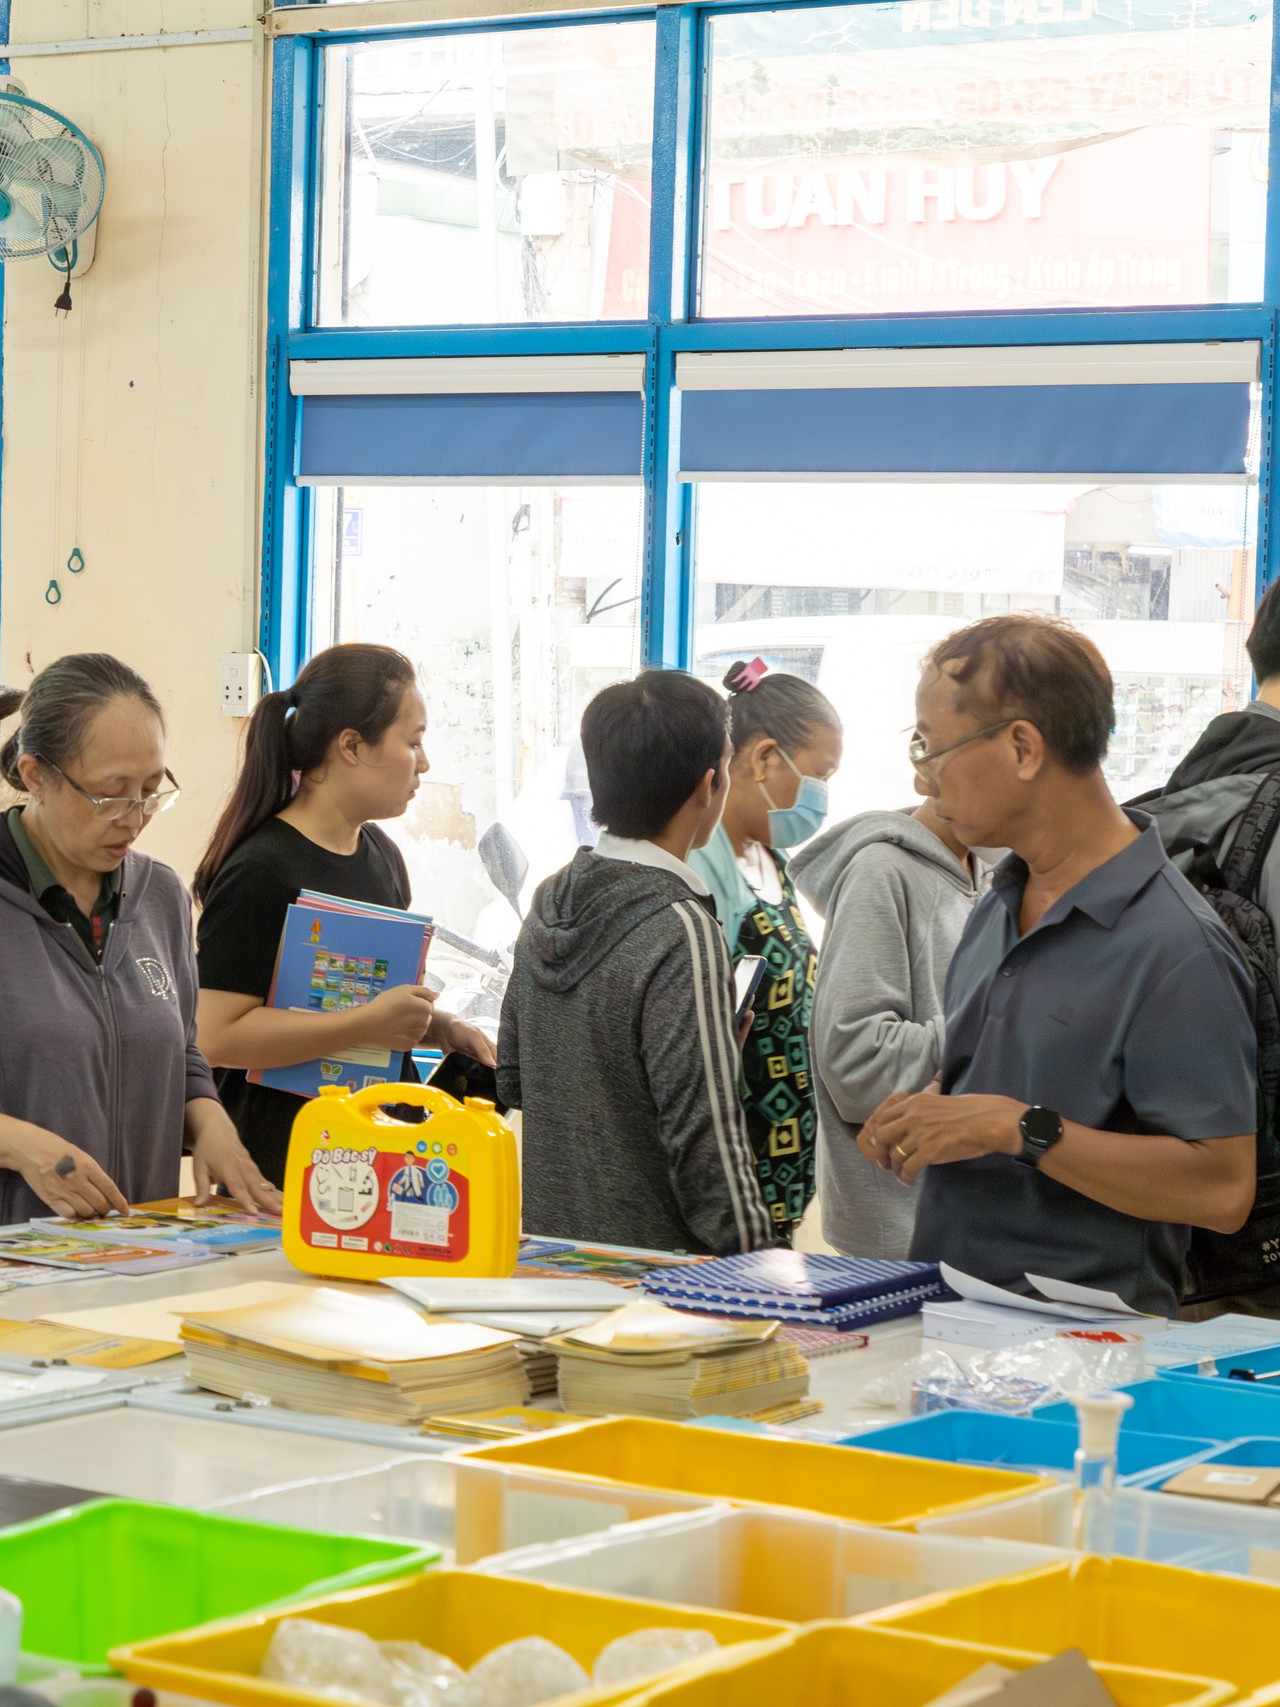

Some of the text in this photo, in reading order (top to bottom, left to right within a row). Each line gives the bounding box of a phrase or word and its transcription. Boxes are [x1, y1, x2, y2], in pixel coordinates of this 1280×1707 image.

[906, 157, 1062, 222] HUY
[1028, 252, 1081, 289] Kính
[1117, 250, 1182, 294] Tròng
